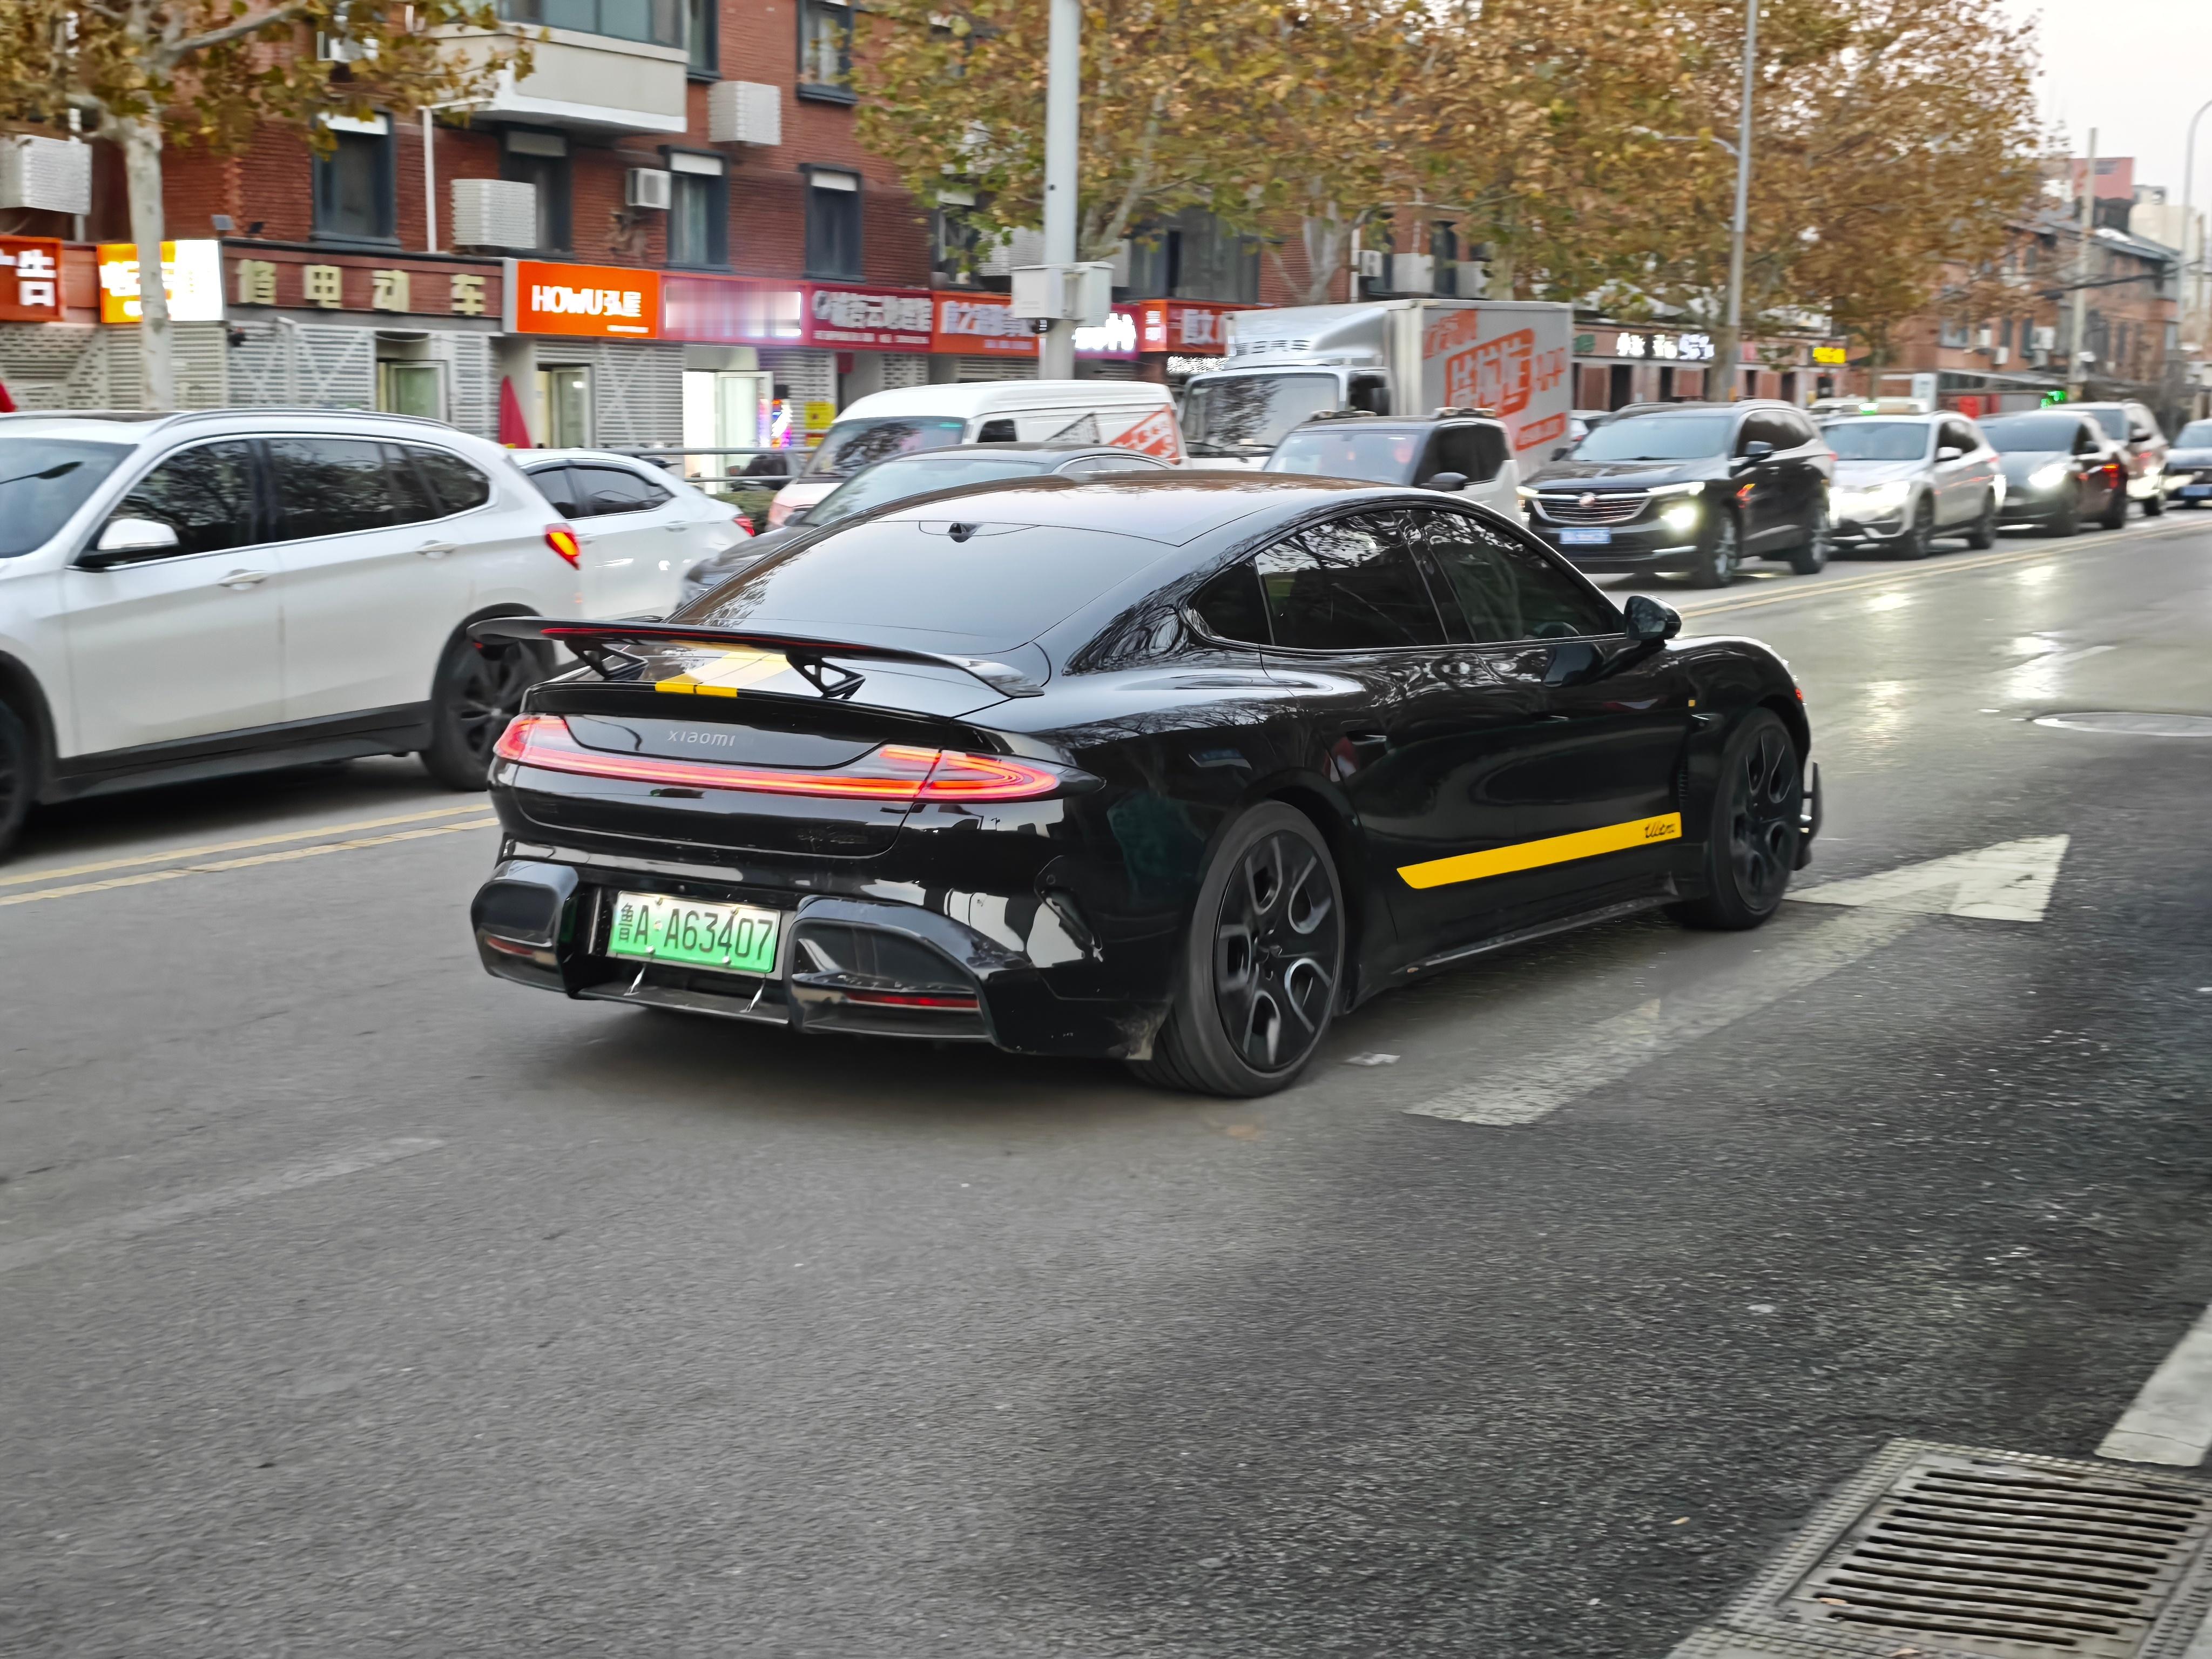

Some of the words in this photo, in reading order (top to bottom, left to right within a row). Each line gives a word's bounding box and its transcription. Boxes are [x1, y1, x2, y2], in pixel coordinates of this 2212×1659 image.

[0, 249, 56, 307] 告
[236, 259, 485, 315] 修电动车
[667, 731, 736, 746] xiaomi
